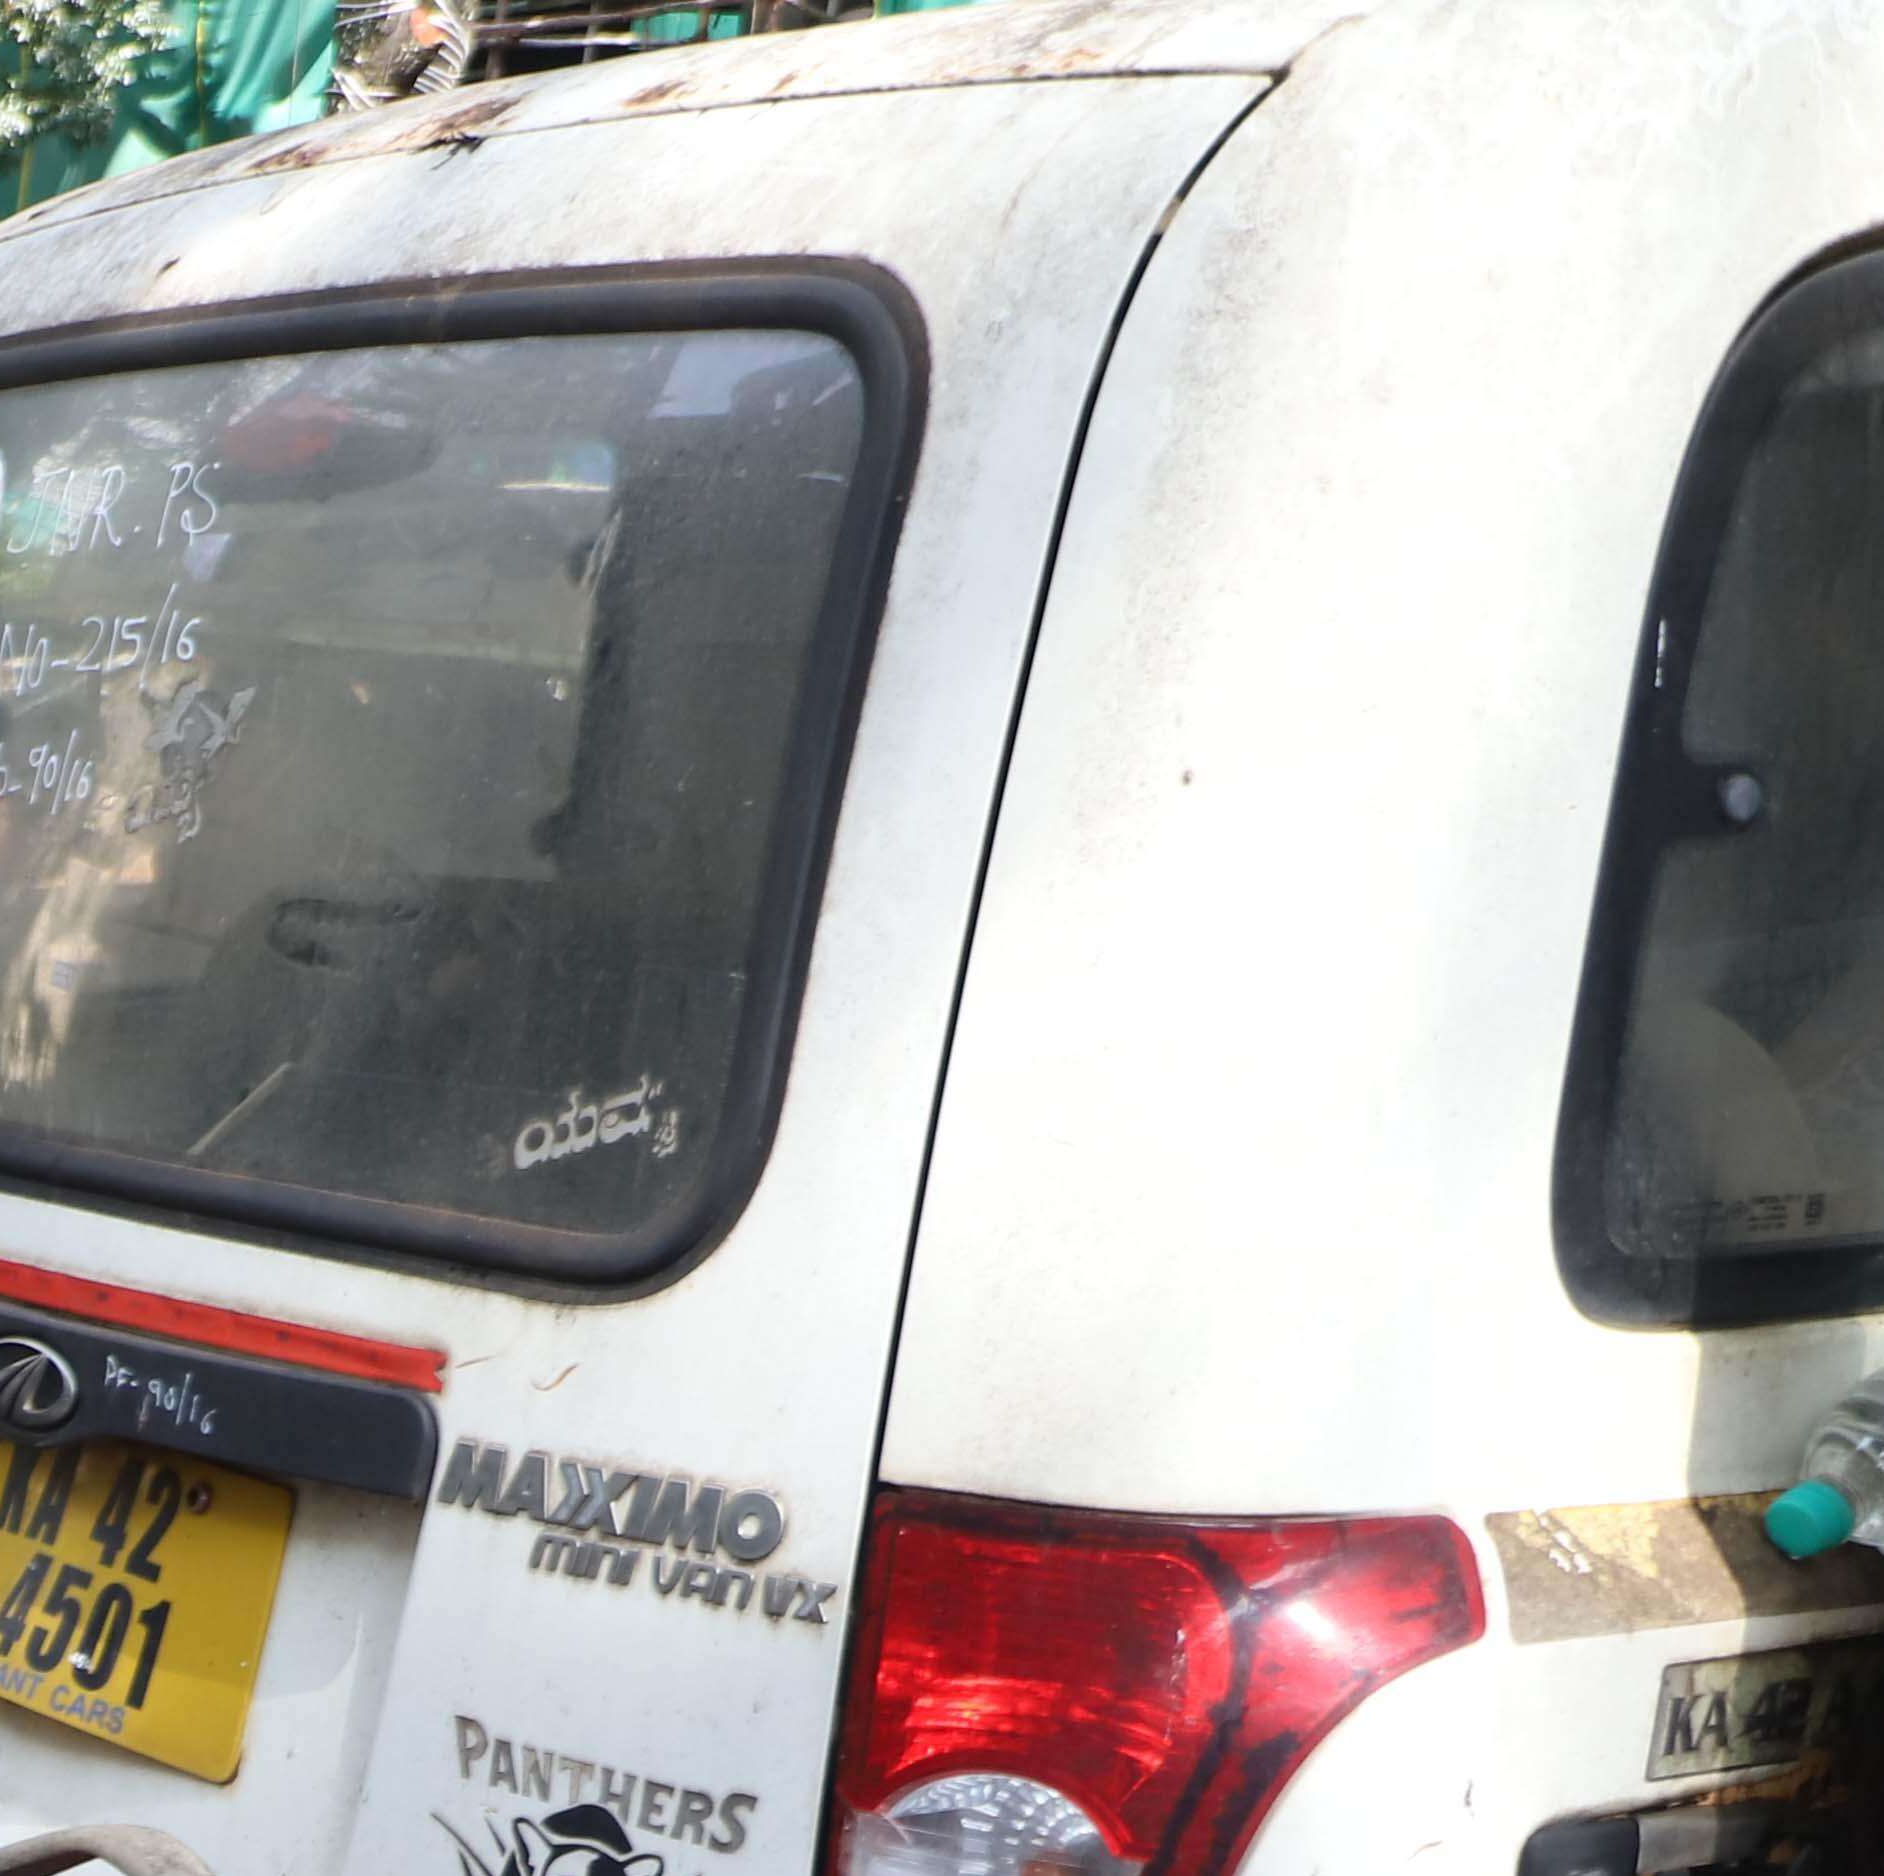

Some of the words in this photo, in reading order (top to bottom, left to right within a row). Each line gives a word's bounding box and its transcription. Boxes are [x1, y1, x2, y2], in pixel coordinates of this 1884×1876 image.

[155, 460, 221, 548] PS
[89, 1459, 182, 1584] 42
[49, 1684, 129, 1735] CARS
[1663, 1691, 1733, 1757] KA
[454, 1714, 759, 1854] PANTHERS
